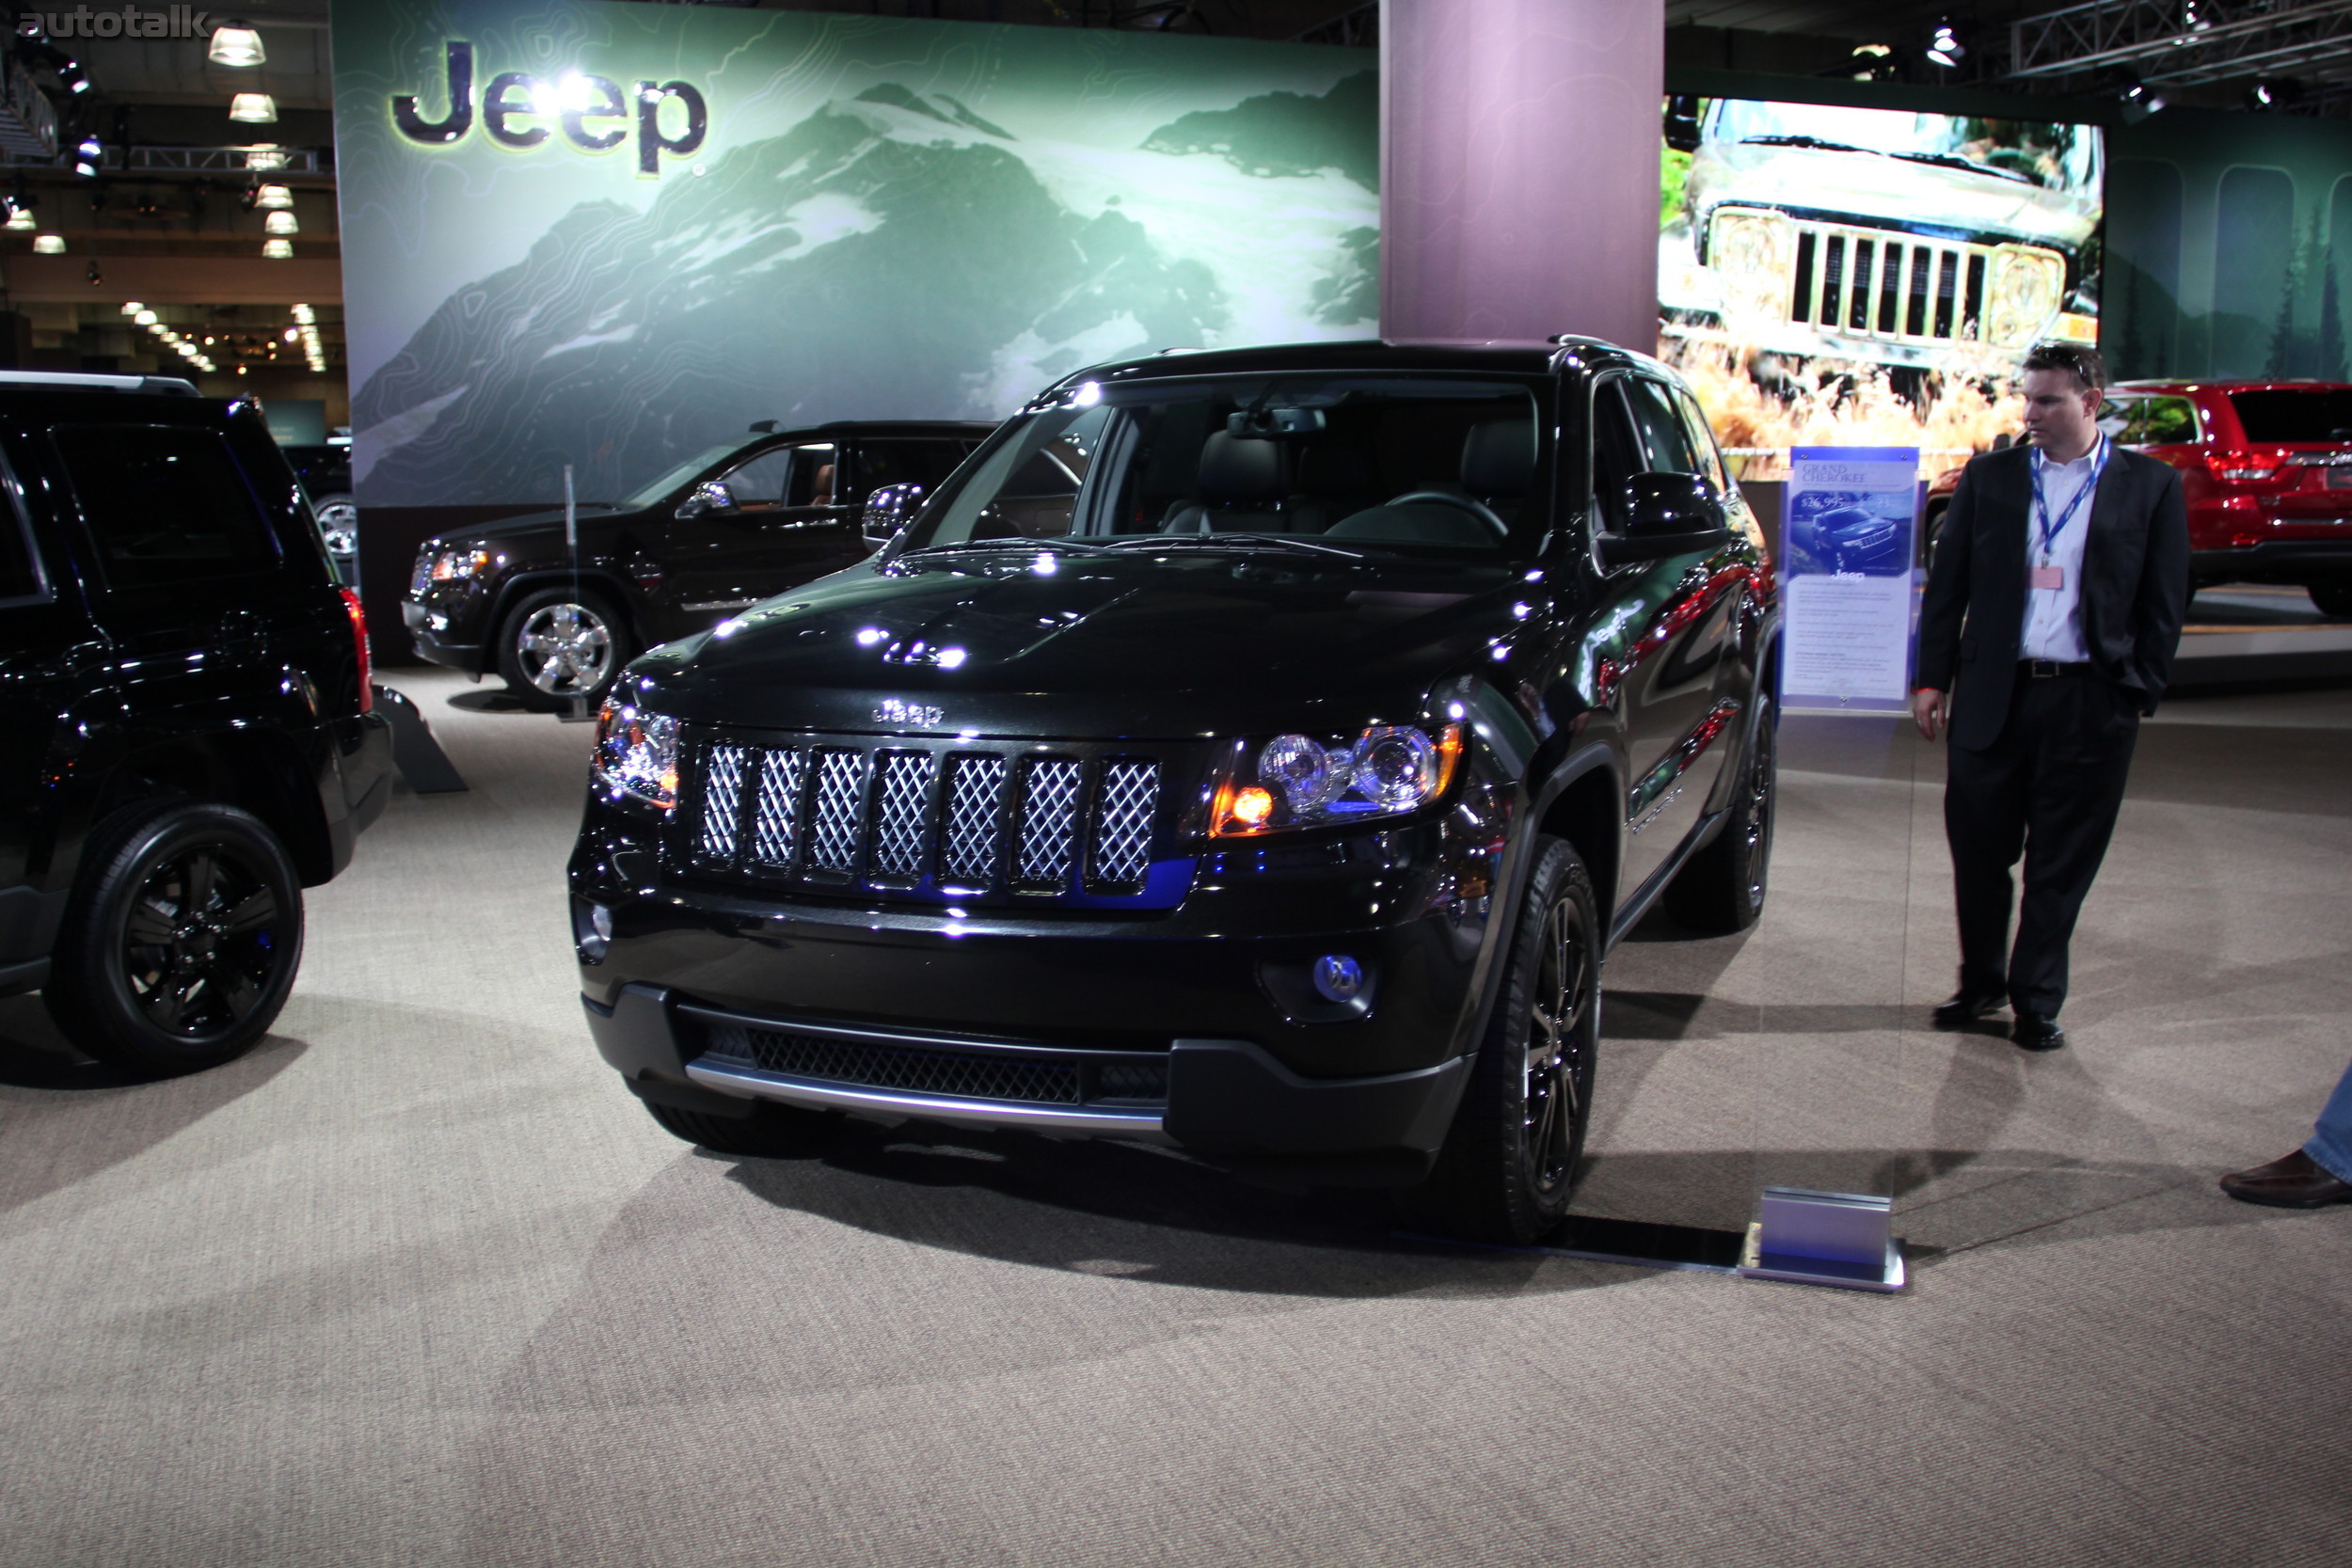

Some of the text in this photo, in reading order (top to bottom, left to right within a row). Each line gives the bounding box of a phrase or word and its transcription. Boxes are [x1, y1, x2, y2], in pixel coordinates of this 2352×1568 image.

[390, 39, 708, 179] Jeep
[1803, 464, 1848, 473] GRAND
[1803, 473, 1867, 483] CHEROKEE
[1830, 568, 1866, 583] Jeep
[871, 700, 944, 730] Jeep
